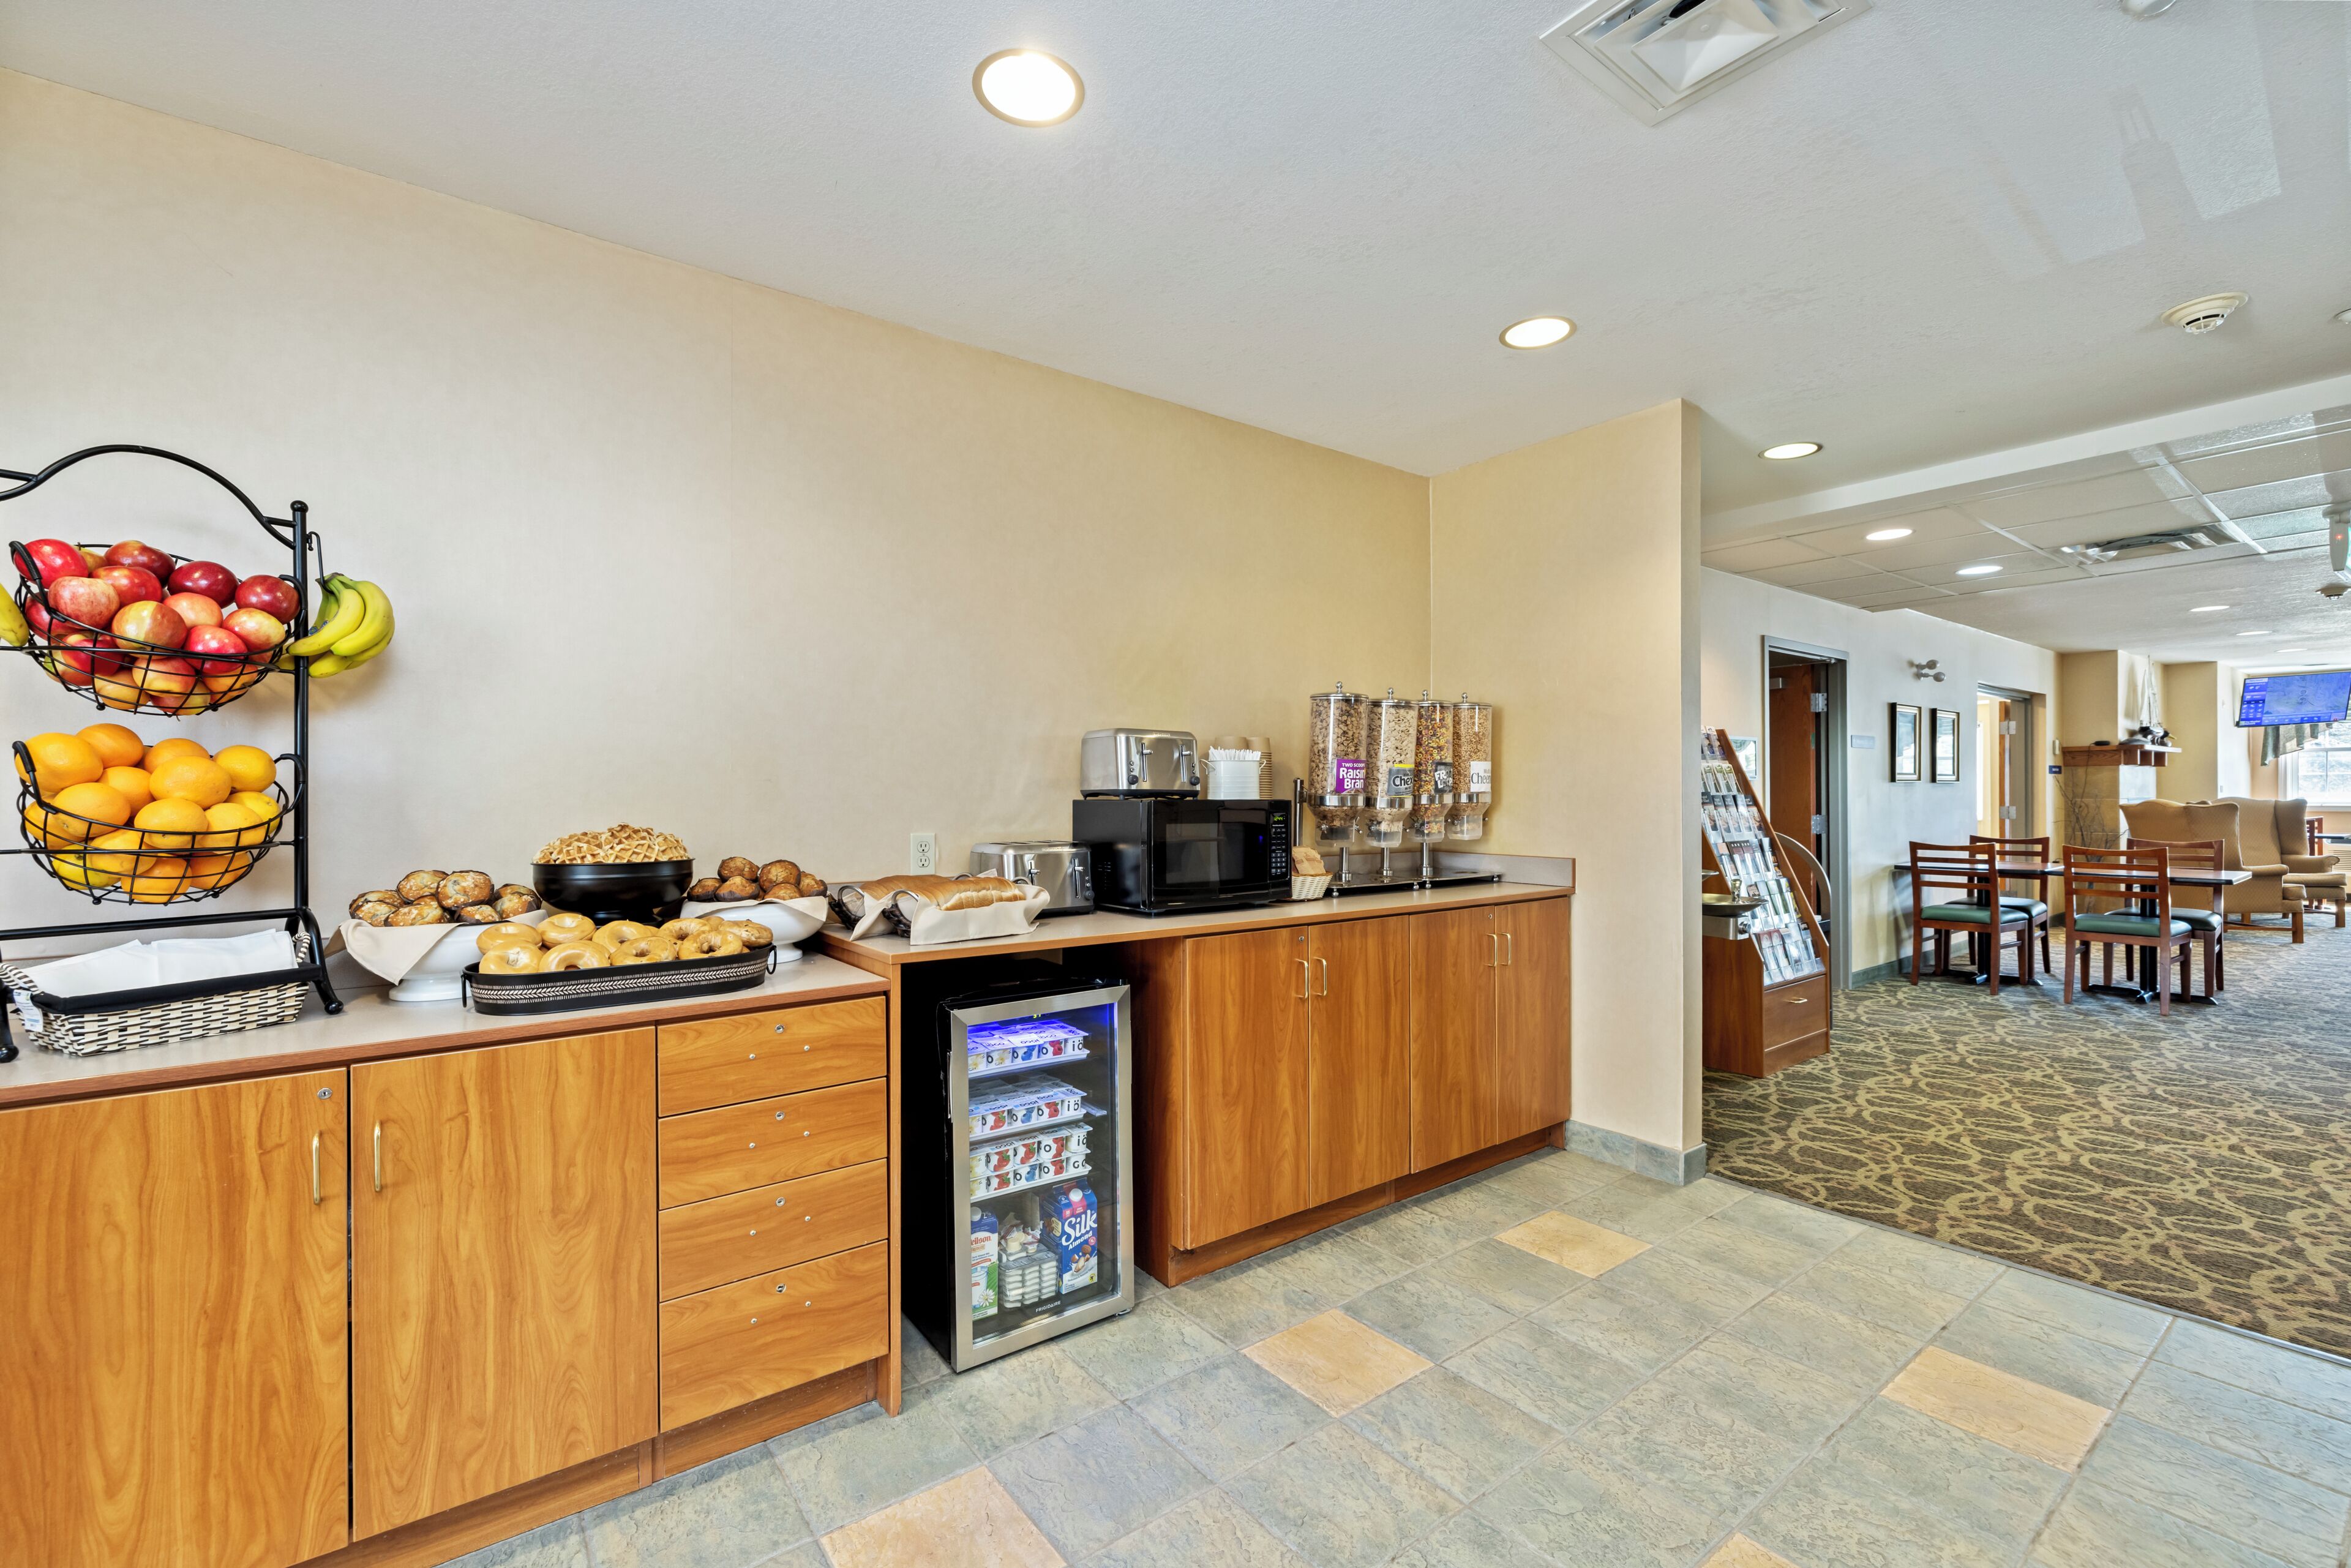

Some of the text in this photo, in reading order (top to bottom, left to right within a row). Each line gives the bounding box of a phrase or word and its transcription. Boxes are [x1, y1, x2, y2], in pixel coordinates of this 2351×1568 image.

[1340, 767, 1365, 779] Raisin
[1344, 778, 1364, 789] Bran
[1392, 775, 1413, 787] Chex
[1061, 1209, 1098, 1246] Silk
[970, 1236, 991, 1246] eilson
[1068, 1231, 1092, 1251] Almond
[1035, 1300, 1061, 1313] FRIGIDAIRE
